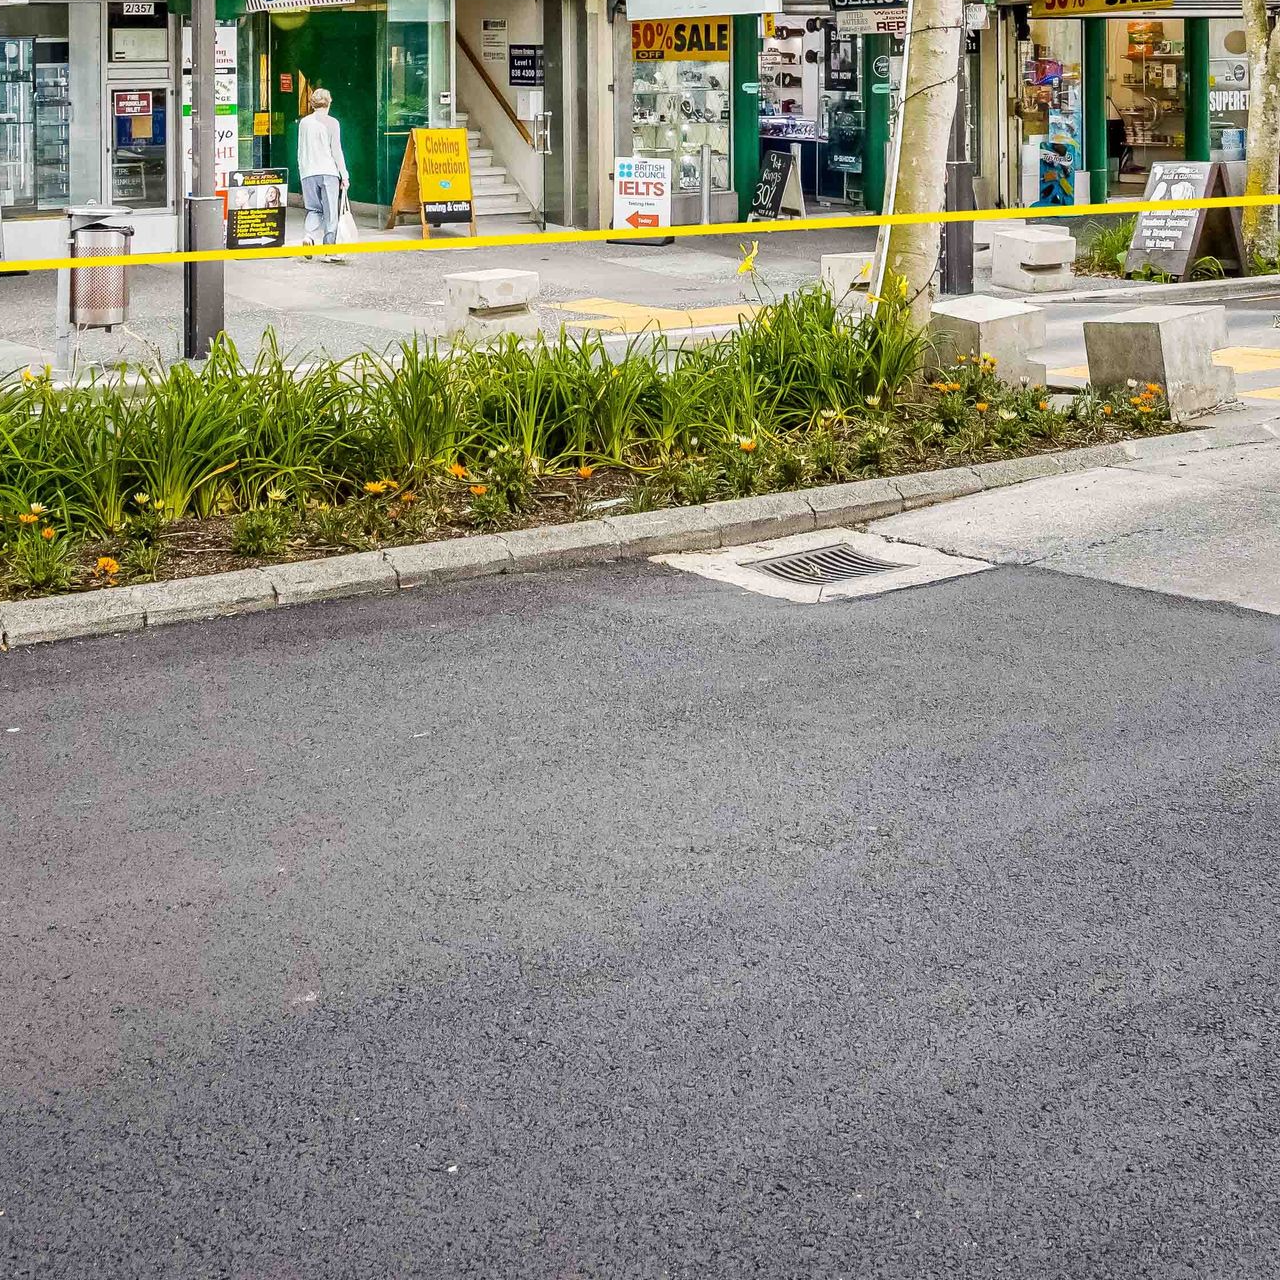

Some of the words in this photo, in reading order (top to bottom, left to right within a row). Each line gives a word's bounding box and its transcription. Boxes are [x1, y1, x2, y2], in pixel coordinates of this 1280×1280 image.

[125, 3, 153, 14] 2/357
[631, 22, 673, 50] 50%
[674, 23, 728, 52] SALE
[831, 30, 851, 41] SALE
[638, 51, 662, 59] OFF
[831, 71, 839, 80] ON
[839, 71, 852, 80] NOW
[1209, 90, 1249, 112] SUPERET
[425, 135, 460, 157] Clothing
[422, 157, 467, 176] Alterations
[634, 163, 665, 172] BRITISH
[634, 171, 666, 179] COUNCIL
[619, 180, 665, 197] IELTS
[752, 182, 777, 209] 30%
[425, 202, 447, 213] sewing
